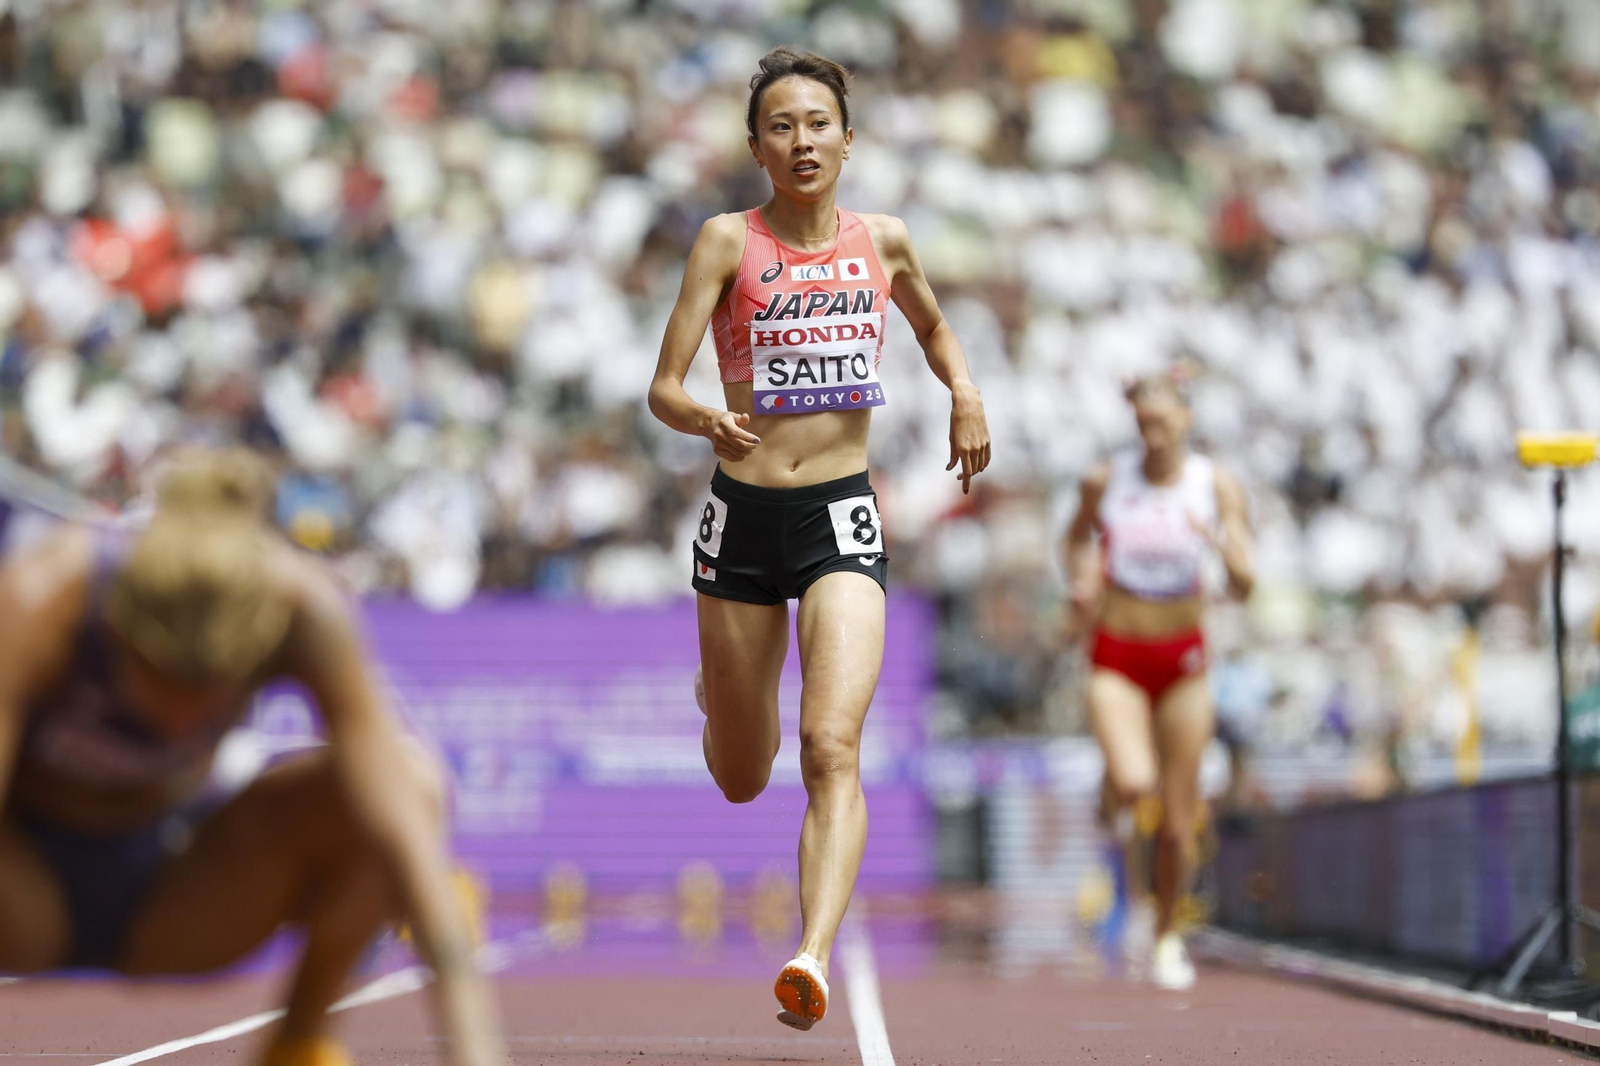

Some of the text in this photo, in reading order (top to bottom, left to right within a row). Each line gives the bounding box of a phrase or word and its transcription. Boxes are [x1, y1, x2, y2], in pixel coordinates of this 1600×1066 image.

[794, 265, 831, 280] ACN
[754, 289, 874, 321] JAPAN
[754, 322, 877, 347] HONDA
[767, 352, 869, 387] SAITO
[699, 501, 716, 544] 8
[850, 505, 877, 546] 8
